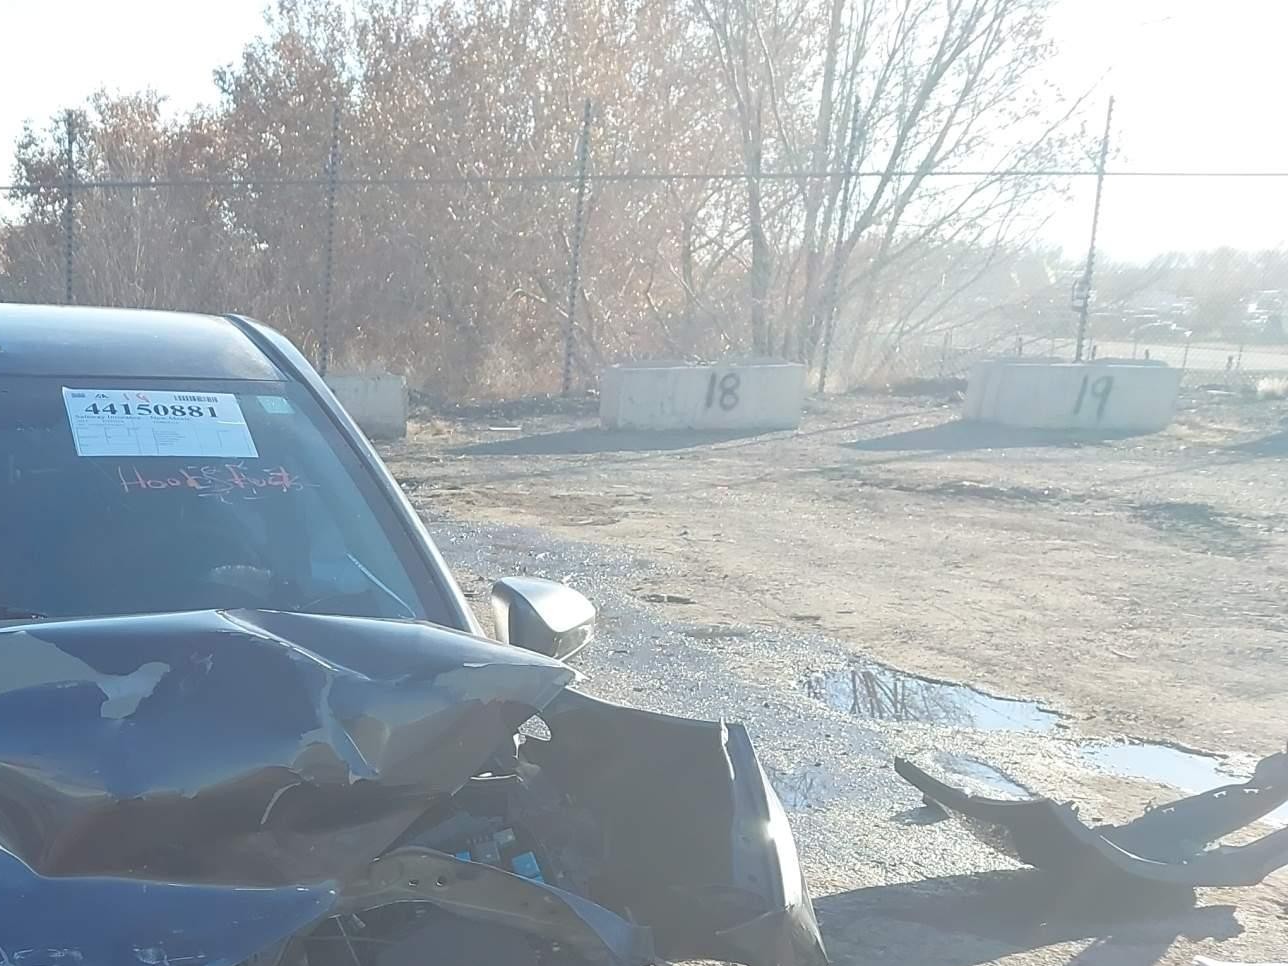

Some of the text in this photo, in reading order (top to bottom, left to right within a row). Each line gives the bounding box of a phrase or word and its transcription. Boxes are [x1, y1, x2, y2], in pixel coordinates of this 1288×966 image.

[85, 403, 217, 418] 44150881
[706, 372, 740, 412] 18
[1073, 374, 1115, 424] 19
